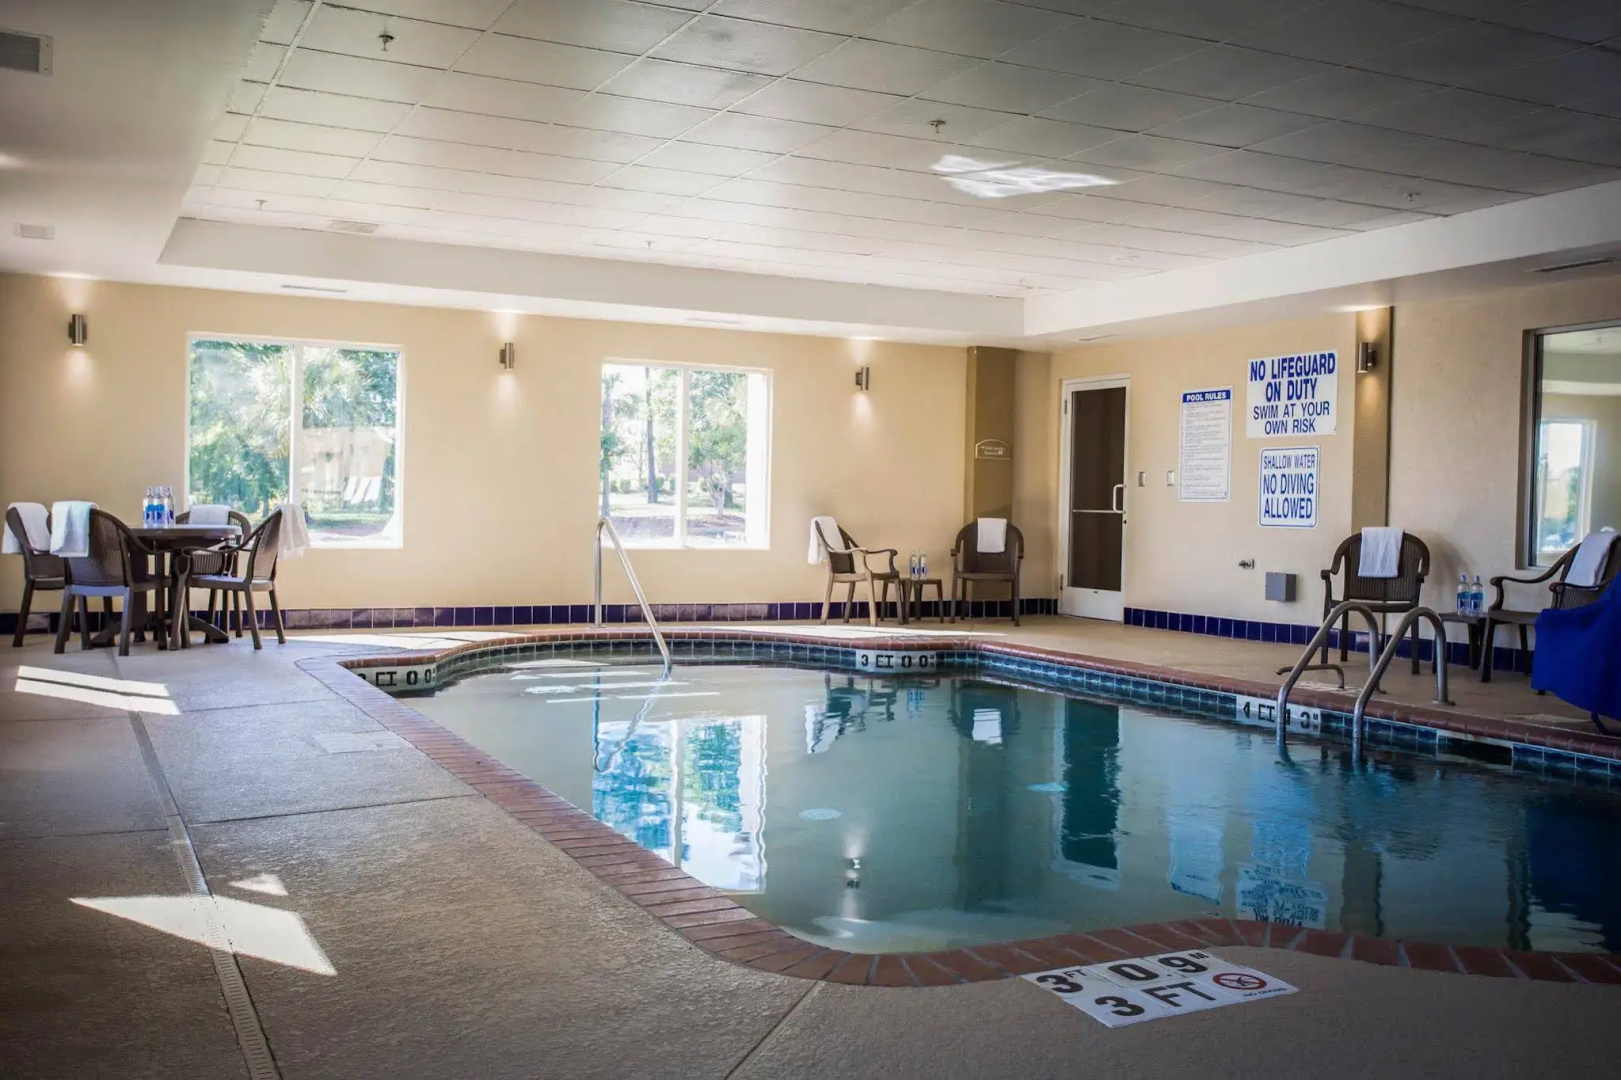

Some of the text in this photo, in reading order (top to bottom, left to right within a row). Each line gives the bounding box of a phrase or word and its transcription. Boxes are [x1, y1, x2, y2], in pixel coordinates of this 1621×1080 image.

[1250, 353, 1336, 381] NO LIFEGUARD
[1187, 392, 1226, 401] POOL RULES
[1266, 378, 1317, 402] ON DUTY
[1254, 402, 1330, 419] SWIM AT YOUR
[1265, 419, 1316, 434] OWN RISK
[1264, 455, 1315, 469] SHALLOW WATER
[1263, 473, 1313, 494] NO DIVING
[1264, 498, 1312, 518] ALLOWED
[1094, 982, 1216, 1016] 3 FT
